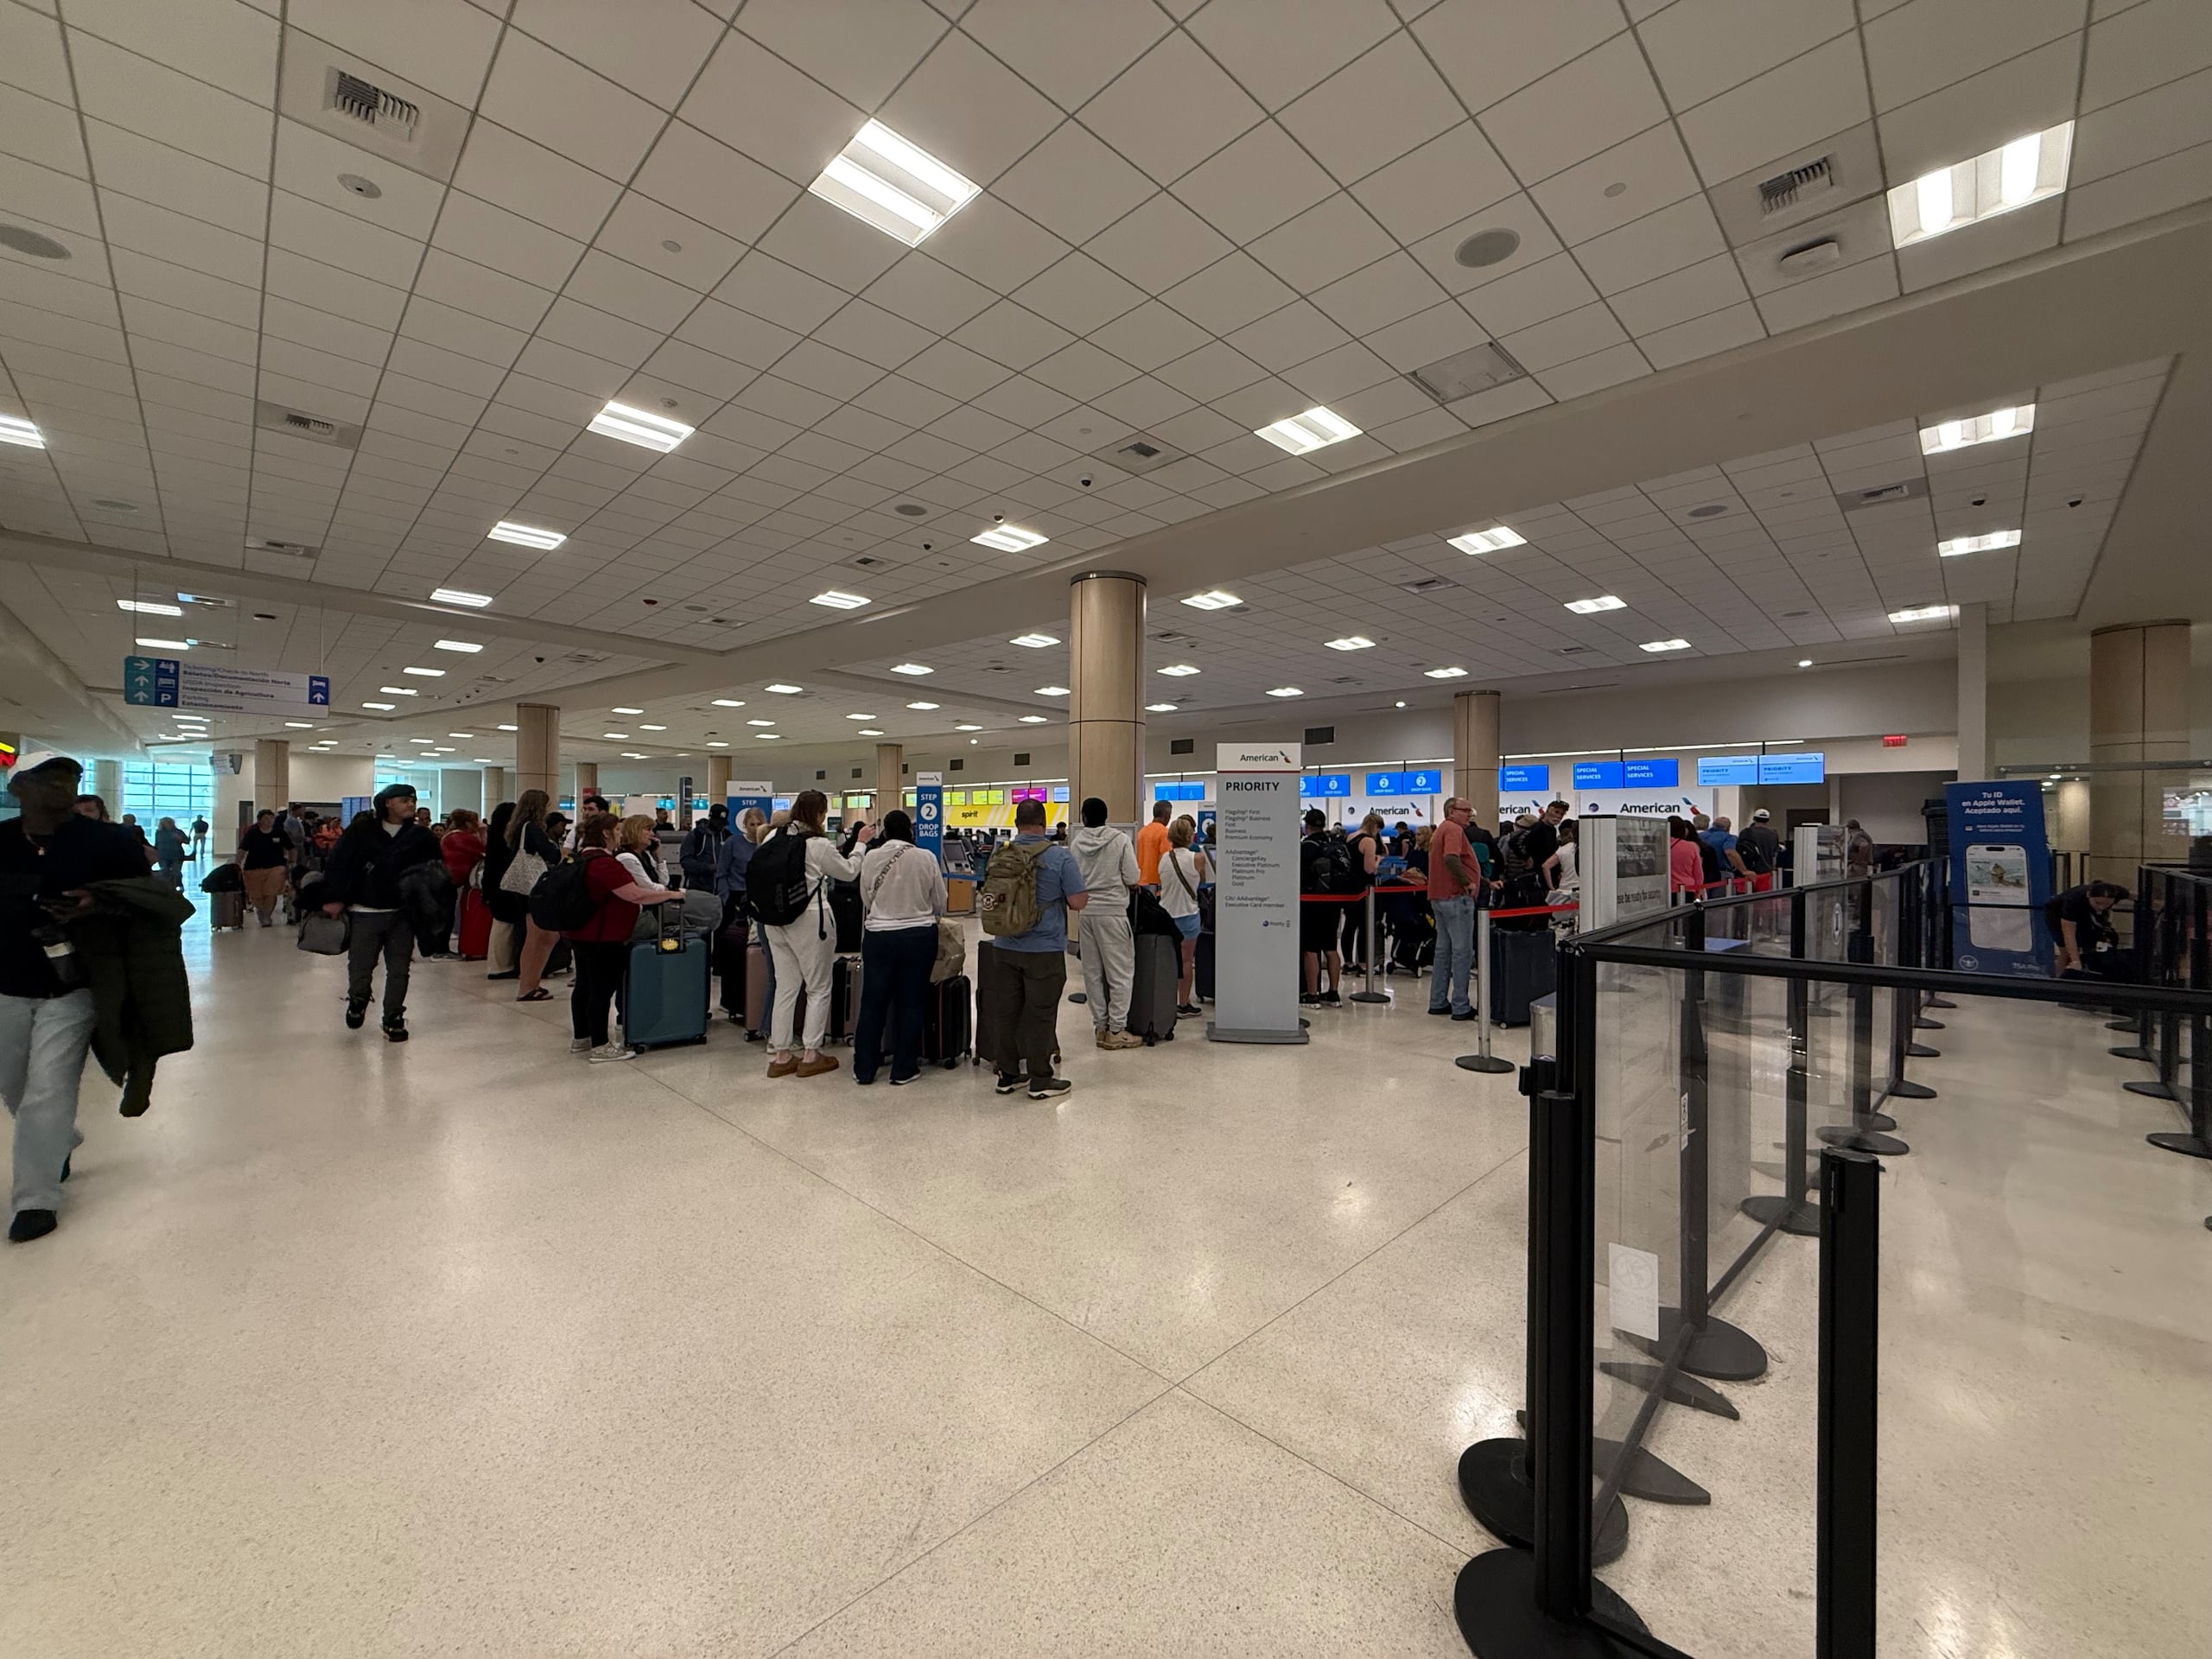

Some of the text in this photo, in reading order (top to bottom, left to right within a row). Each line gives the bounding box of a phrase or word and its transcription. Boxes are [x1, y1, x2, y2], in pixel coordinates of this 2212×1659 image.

[1225, 782, 1280, 791] PRIORITY
[925, 806, 932, 817] 2
[1370, 806, 1409, 815] American
[1499, 804, 1530, 814] erican
[1620, 803, 1680, 813] American
[962, 810, 978, 819] spirit
